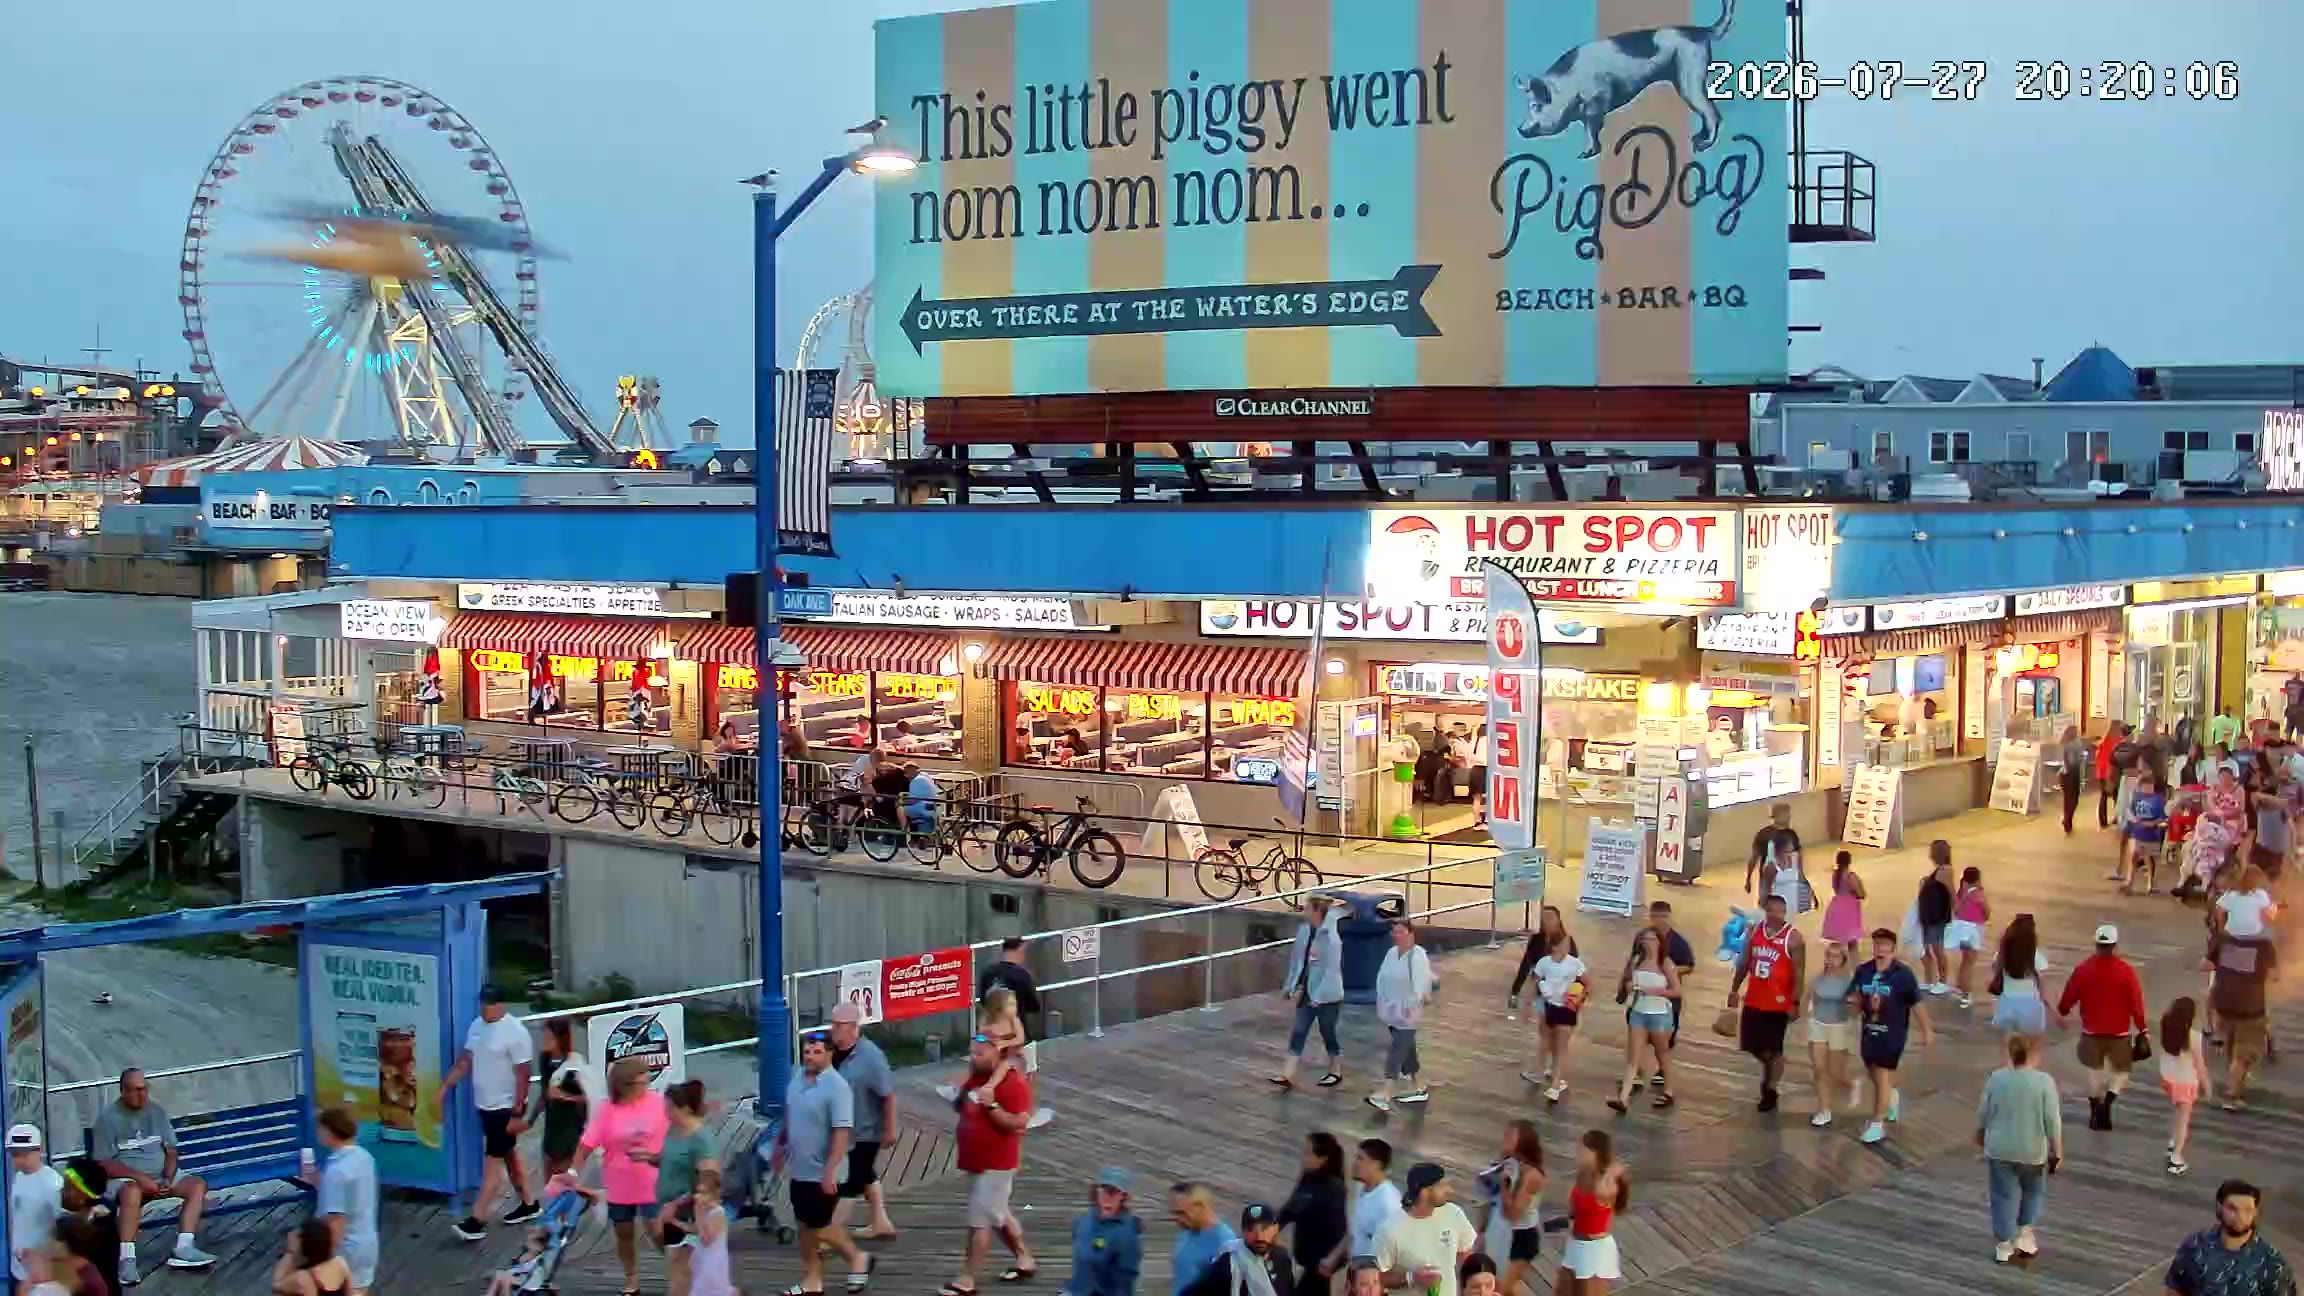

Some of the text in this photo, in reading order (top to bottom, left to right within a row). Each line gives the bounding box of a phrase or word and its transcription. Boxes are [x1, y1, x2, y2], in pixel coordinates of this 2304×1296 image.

[911, 49, 1455, 162] This little piggy went
[910, 163, 1370, 243] nom nom nom...
[1488, 125, 1765, 259] PigDog
[917, 289, 1410, 330] OVER THERE AT THE WATER'S EDGE
[1495, 284, 1748, 311] BEACH BAR BQ
[213, 503, 257, 519] BEACH
[271, 503, 297, 519] BAR
[1465, 515, 1716, 552] HOT SPOT
[1747, 513, 1829, 549] HOT SPOT
[1465, 556, 1718, 575] RESTAURANT & PIZZERIA
[346, 603, 426, 620] OCEAN VIEW
[491, 594, 665, 612] GREEK SPECIALTIES APPETIZE
[831, 602, 1068, 623] TALIAN SAUSAGE WRAPS SALADS
[1246, 601, 1319, 630] HOT
[1337, 600, 1438, 632] SPOT
[390, 622, 425, 637] OPEN
[809, 672, 866, 697] STEAKS
[1028, 688, 1093, 715] SALADS
[1128, 693, 1183, 720] PASTA
[1232, 698, 1296, 726] WRAPS
[1659, 786, 1681, 862] ATM
